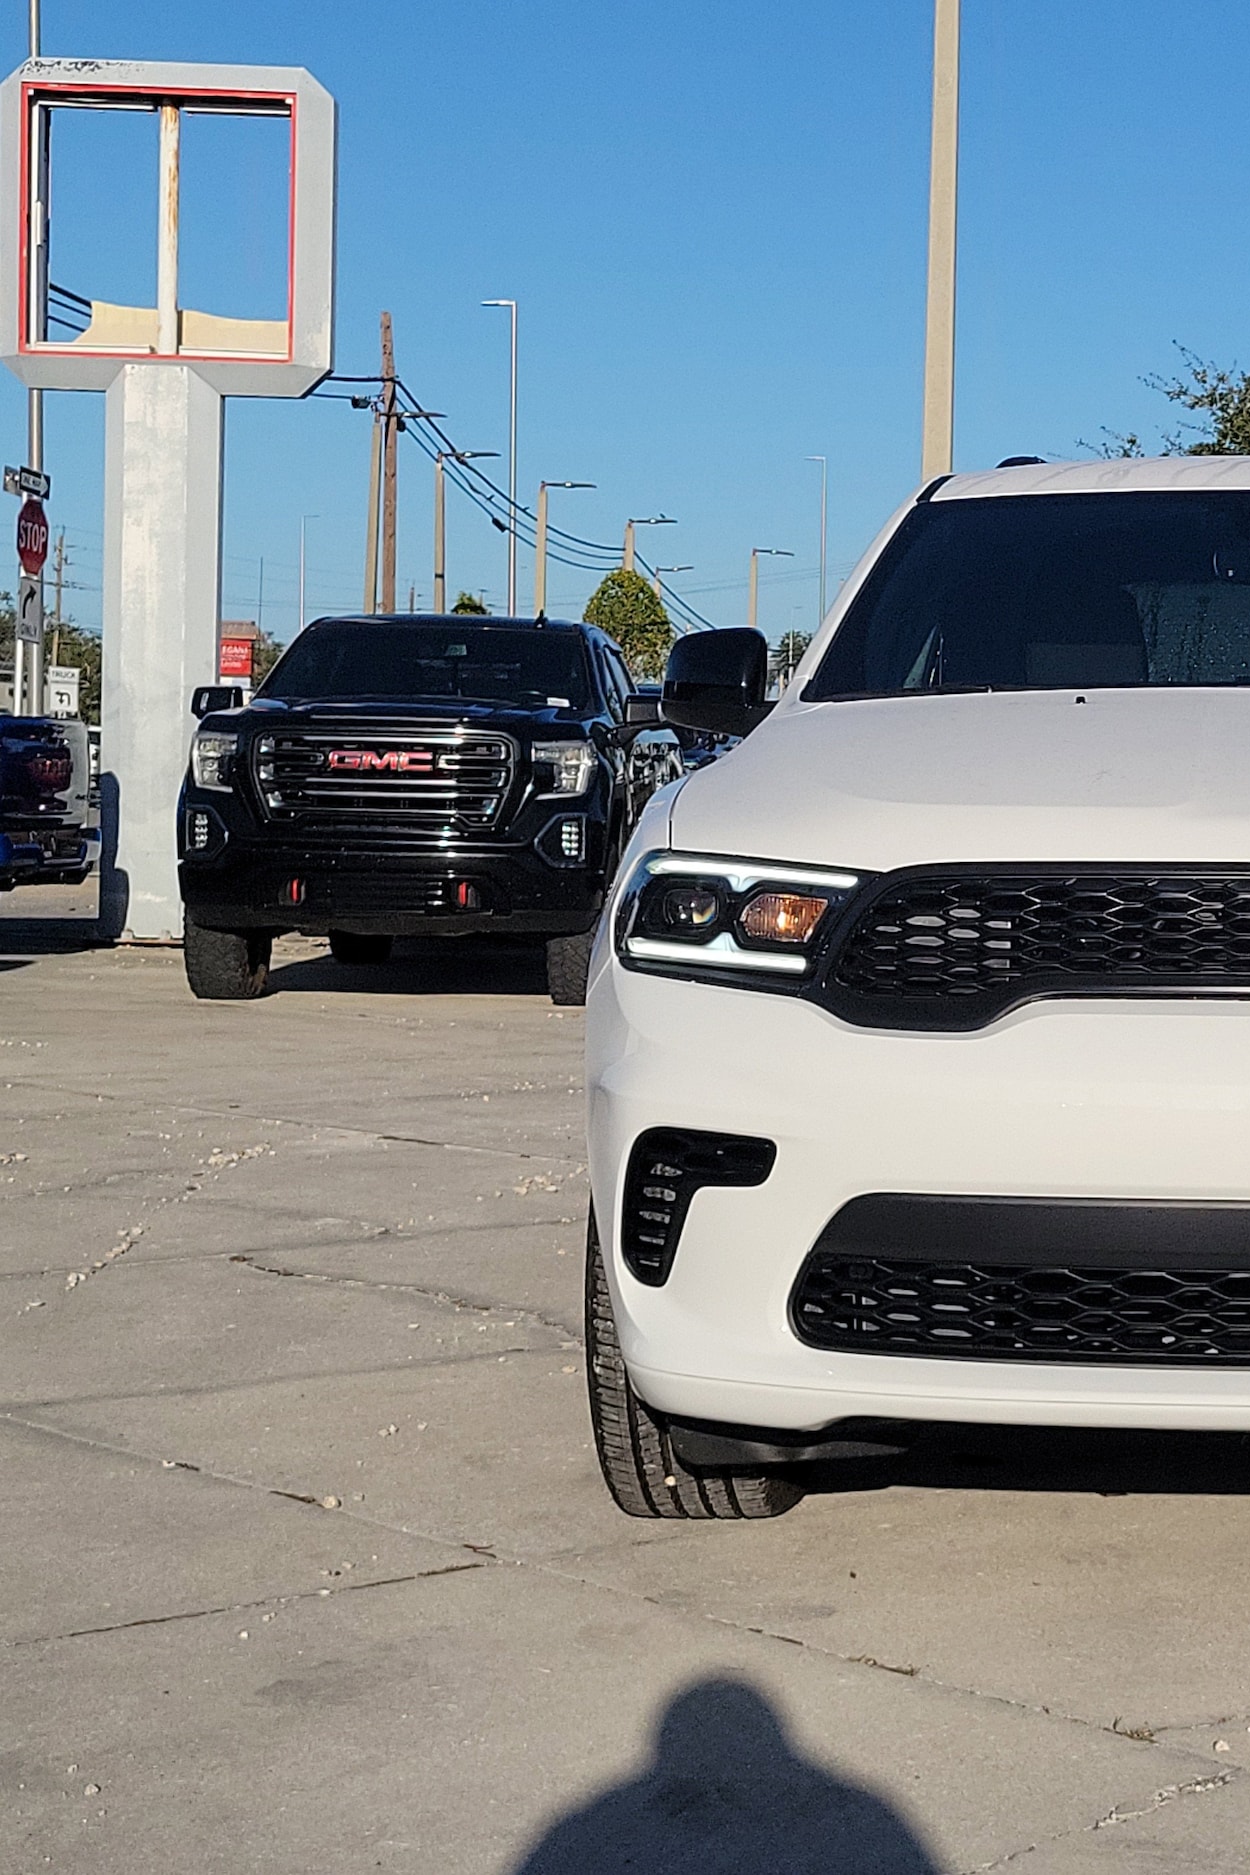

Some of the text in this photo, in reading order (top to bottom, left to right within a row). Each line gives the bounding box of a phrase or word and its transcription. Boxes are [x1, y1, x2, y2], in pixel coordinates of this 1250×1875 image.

[19, 520, 47, 554] STOP
[20, 622, 37, 637] ONLY
[52, 670, 75, 678] TRUCK
[329, 751, 433, 771] GMC
